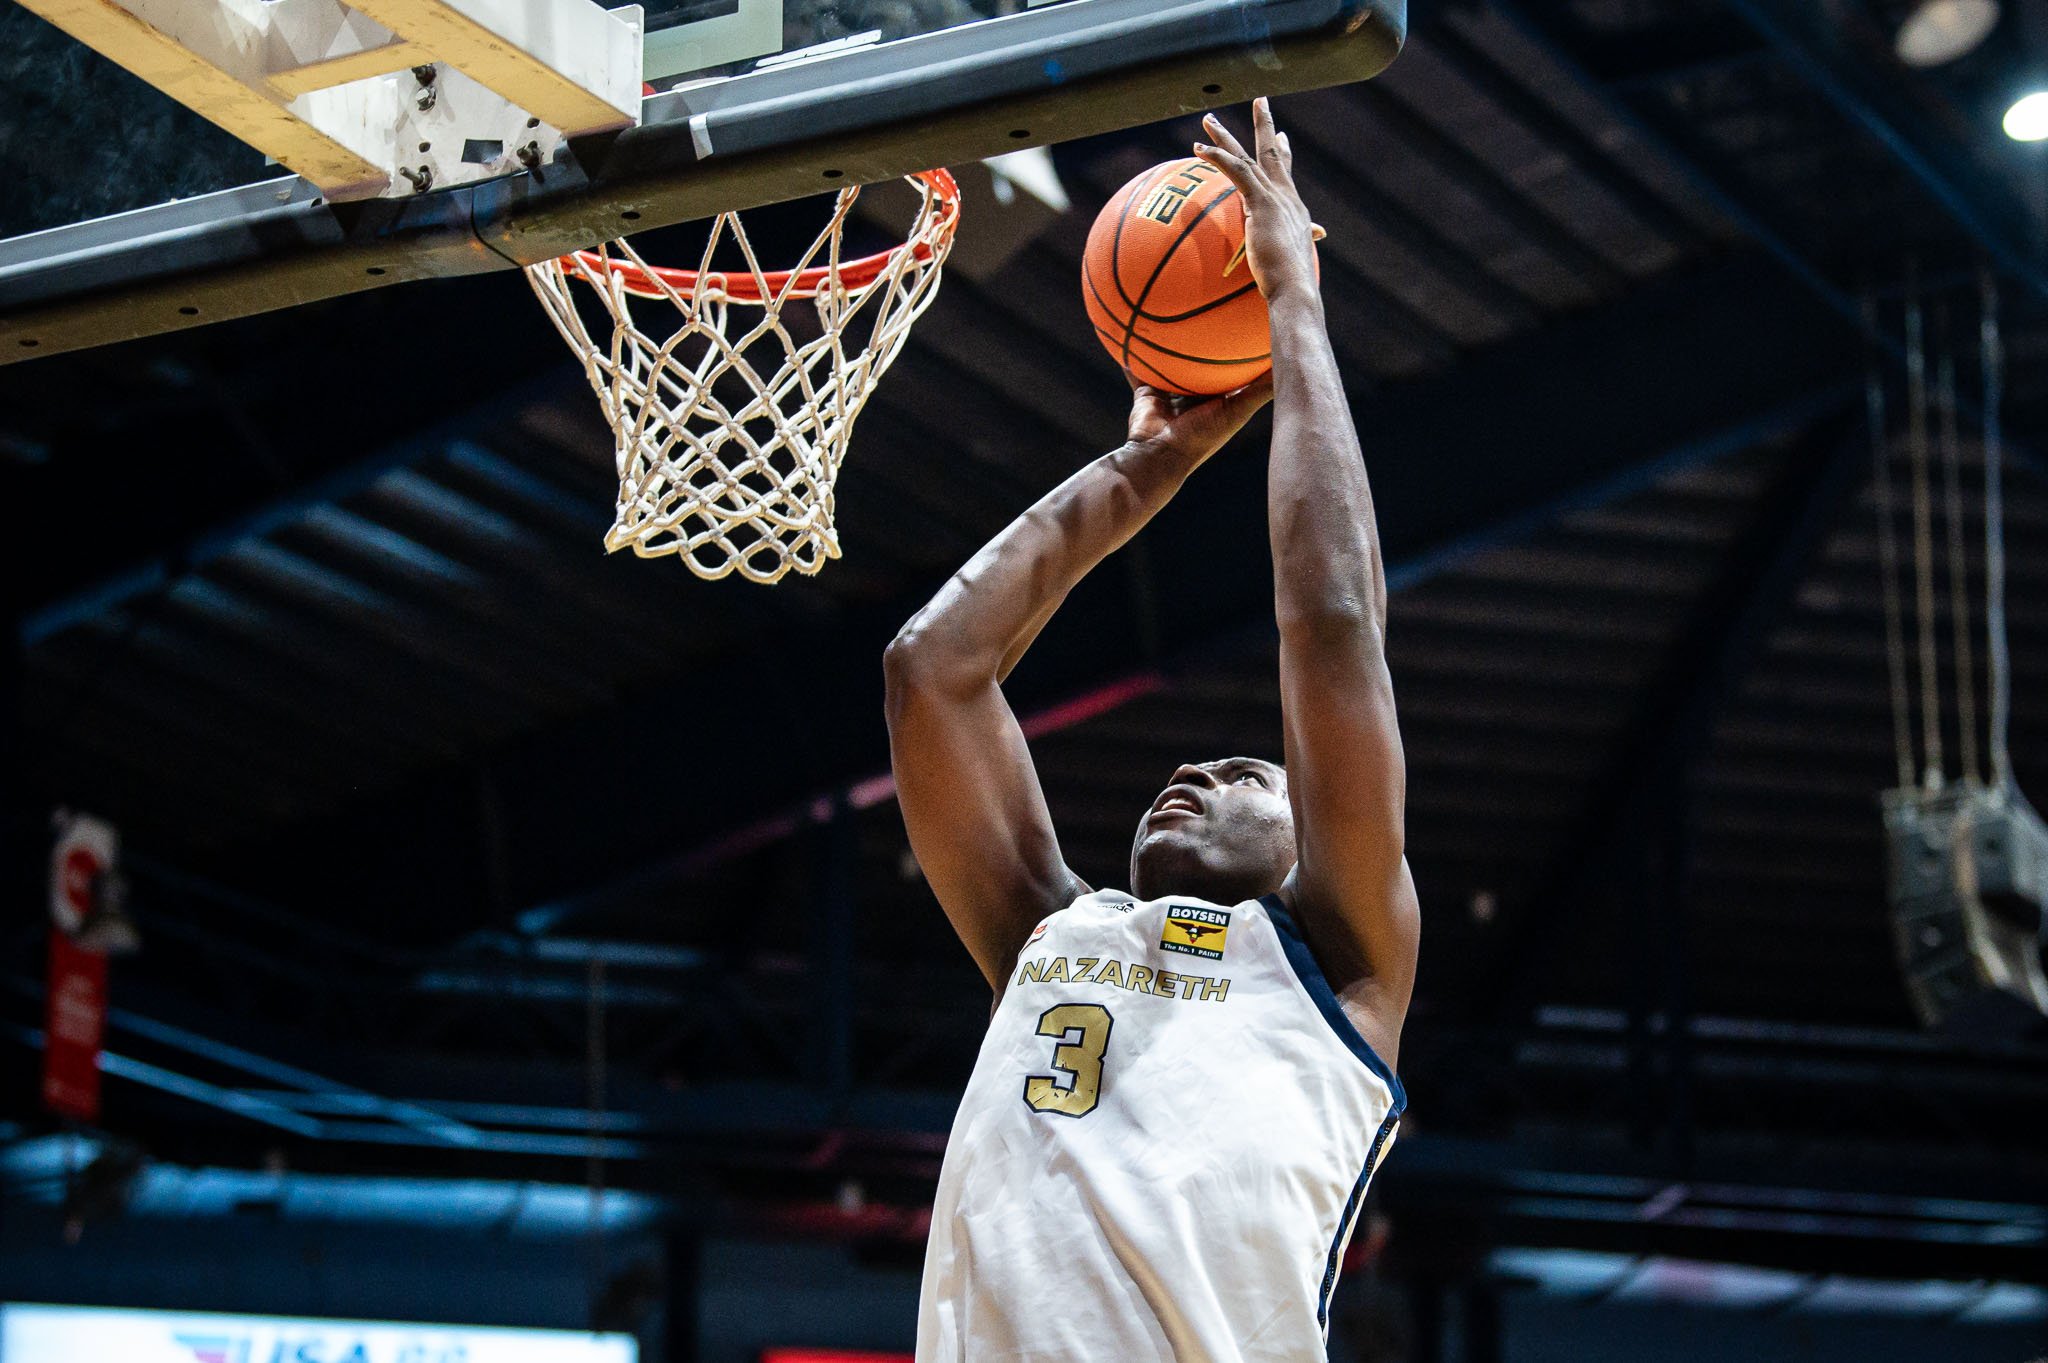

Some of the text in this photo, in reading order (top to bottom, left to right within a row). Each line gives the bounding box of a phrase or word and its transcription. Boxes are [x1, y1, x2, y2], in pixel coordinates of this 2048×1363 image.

[1144, 160, 1219, 225] ELIT
[1171, 908, 1226, 925] BOYSEN
[1164, 943, 1177, 951] The
[1198, 949, 1220, 958] PAINT
[1018, 957, 1231, 1001] NAZARETH
[1022, 1003, 1114, 1119] 3
